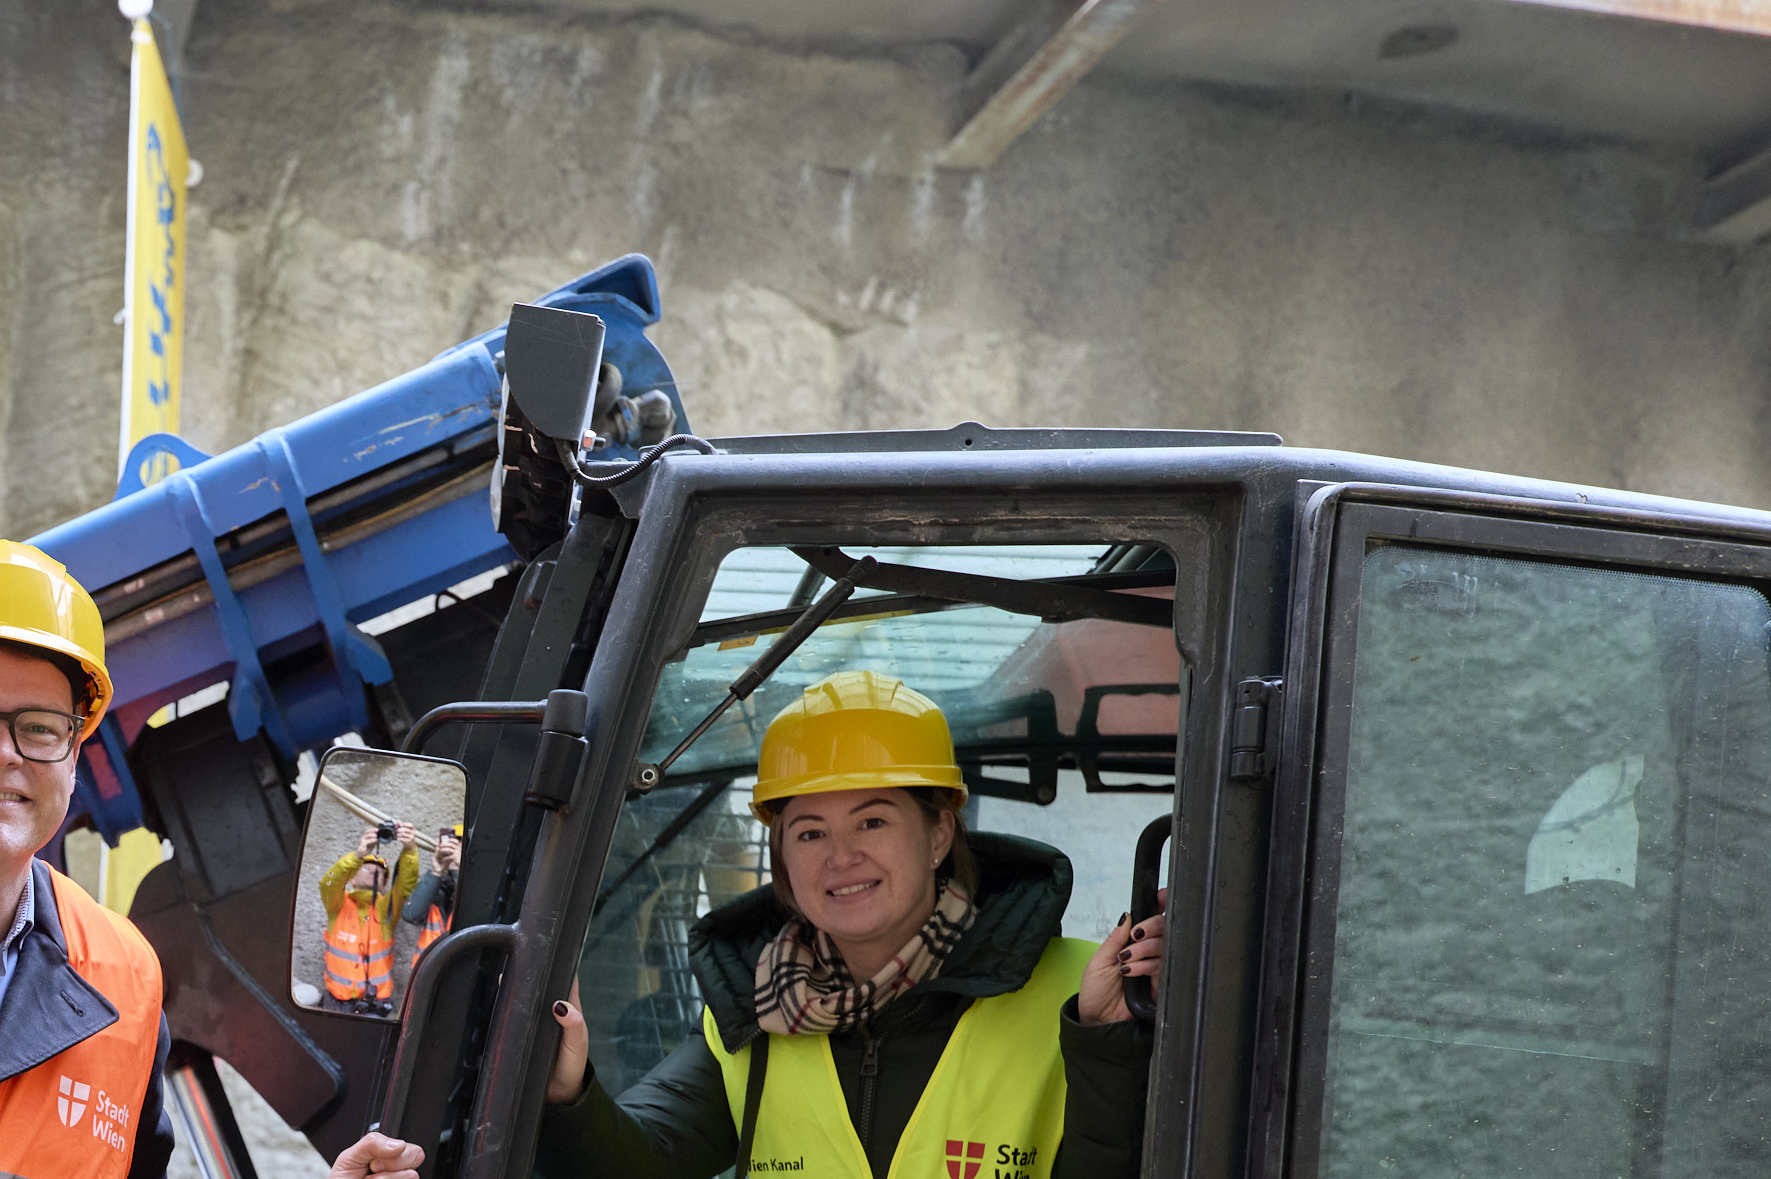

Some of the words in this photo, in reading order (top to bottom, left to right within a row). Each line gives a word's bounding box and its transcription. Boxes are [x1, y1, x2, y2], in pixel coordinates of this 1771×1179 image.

[95, 1089, 130, 1129] Stadt
[92, 1113, 126, 1153] Wien
[749, 1159, 769, 1172] ien
[770, 1156, 804, 1171] Kanal
